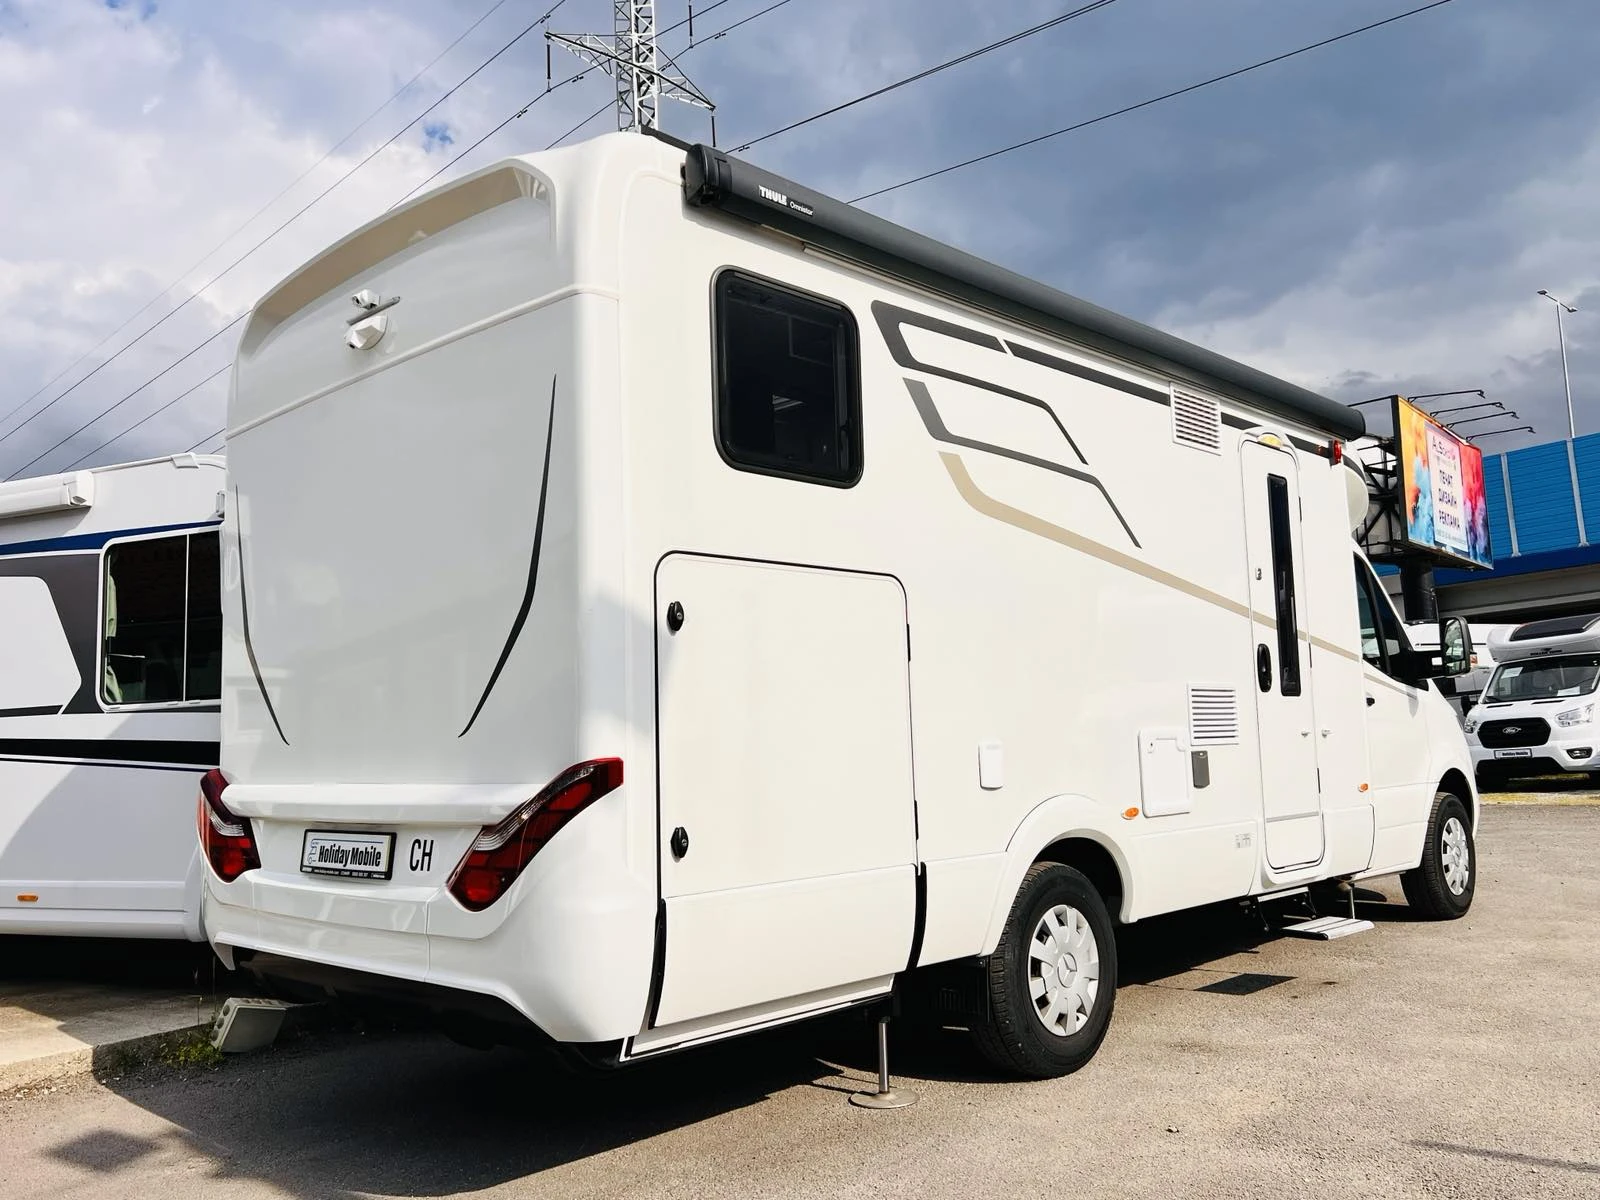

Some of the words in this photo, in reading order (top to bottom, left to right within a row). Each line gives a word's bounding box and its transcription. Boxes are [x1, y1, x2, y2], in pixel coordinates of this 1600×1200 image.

[759, 185, 788, 206] THULE
[789, 201, 814, 216] Omnistor
[318, 843, 350, 868] Holiday
[351, 845, 382, 867] Mobile
[409, 839, 434, 872] CH
